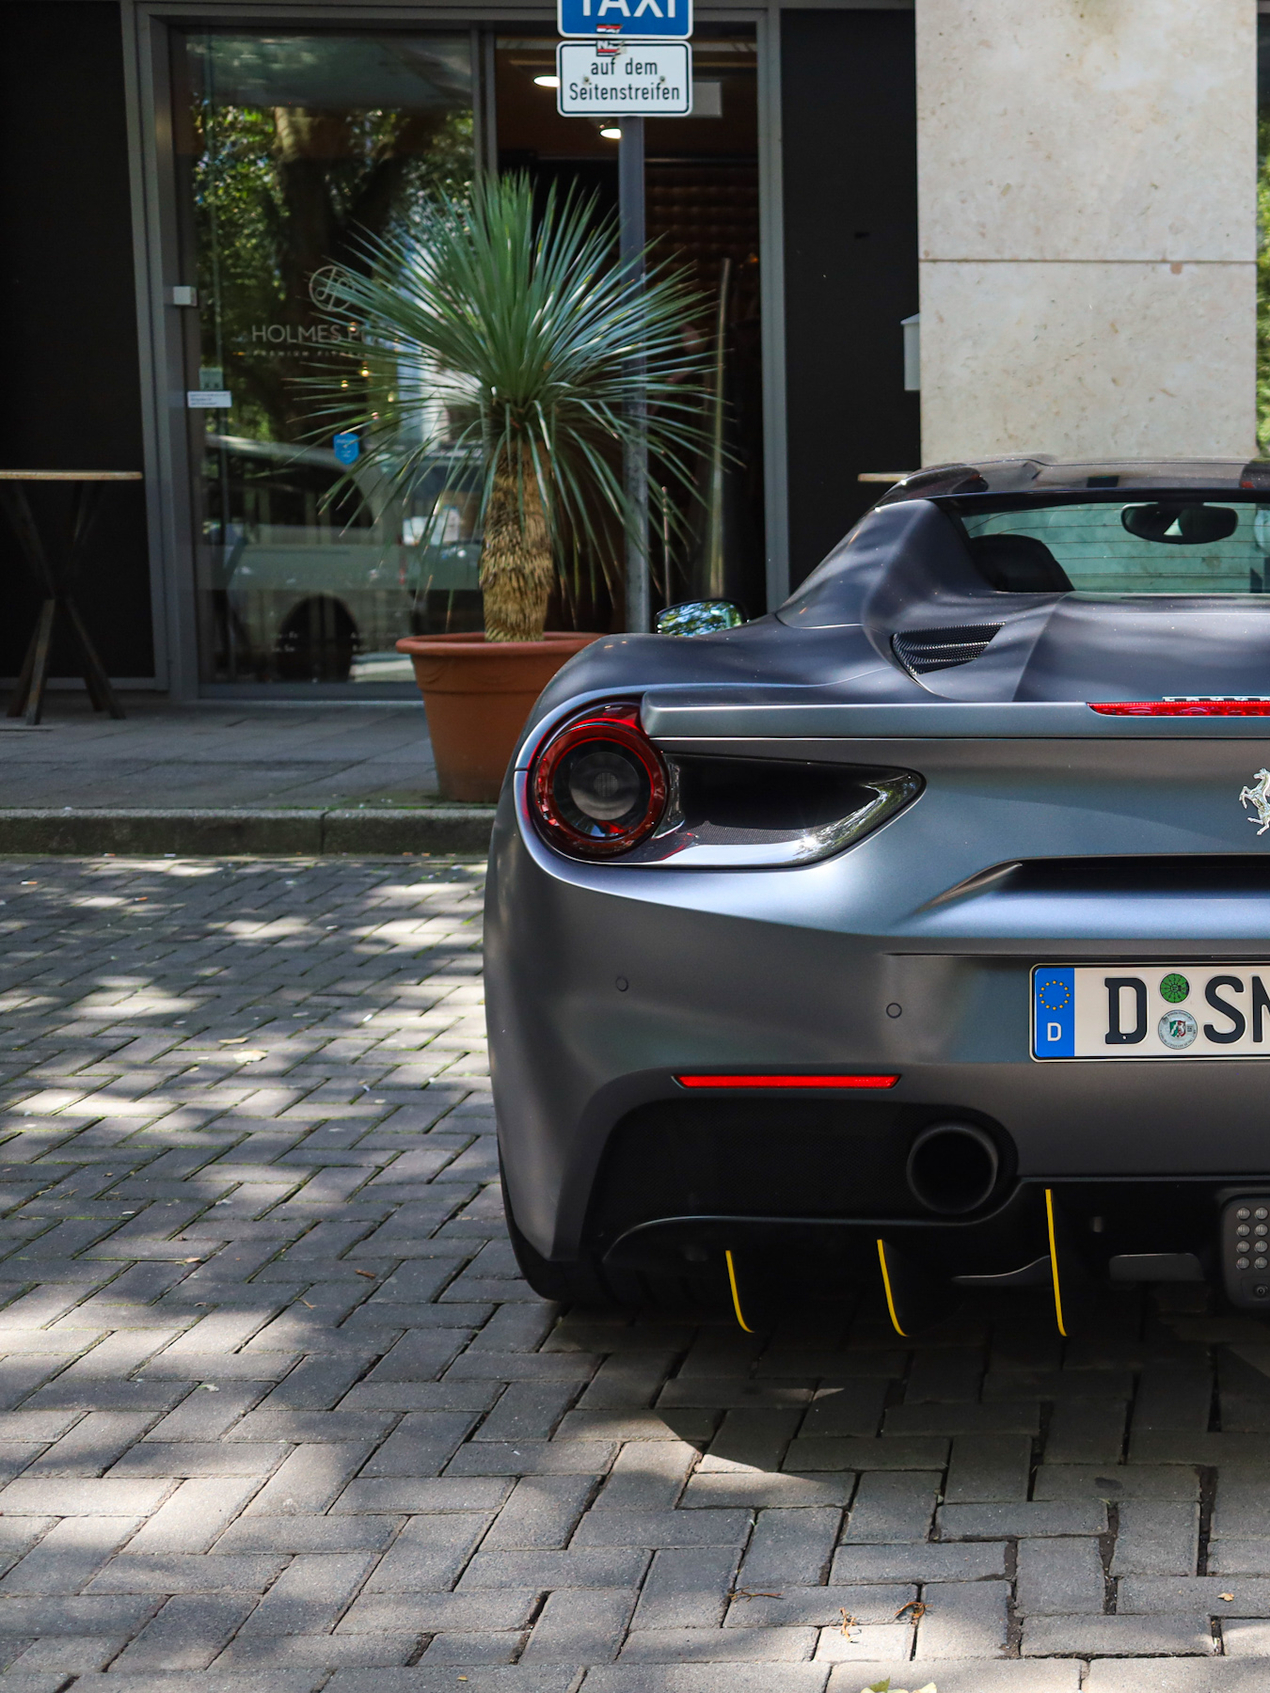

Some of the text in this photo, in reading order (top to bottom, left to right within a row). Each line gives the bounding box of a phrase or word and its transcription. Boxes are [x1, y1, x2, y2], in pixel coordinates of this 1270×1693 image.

[590, 57, 658, 75] auf dem
[569, 82, 680, 101] Seitenstreifen
[251, 324, 341, 343] HOLMES
[1104, 976, 1148, 1044] D
[1047, 1022, 1062, 1041] D
